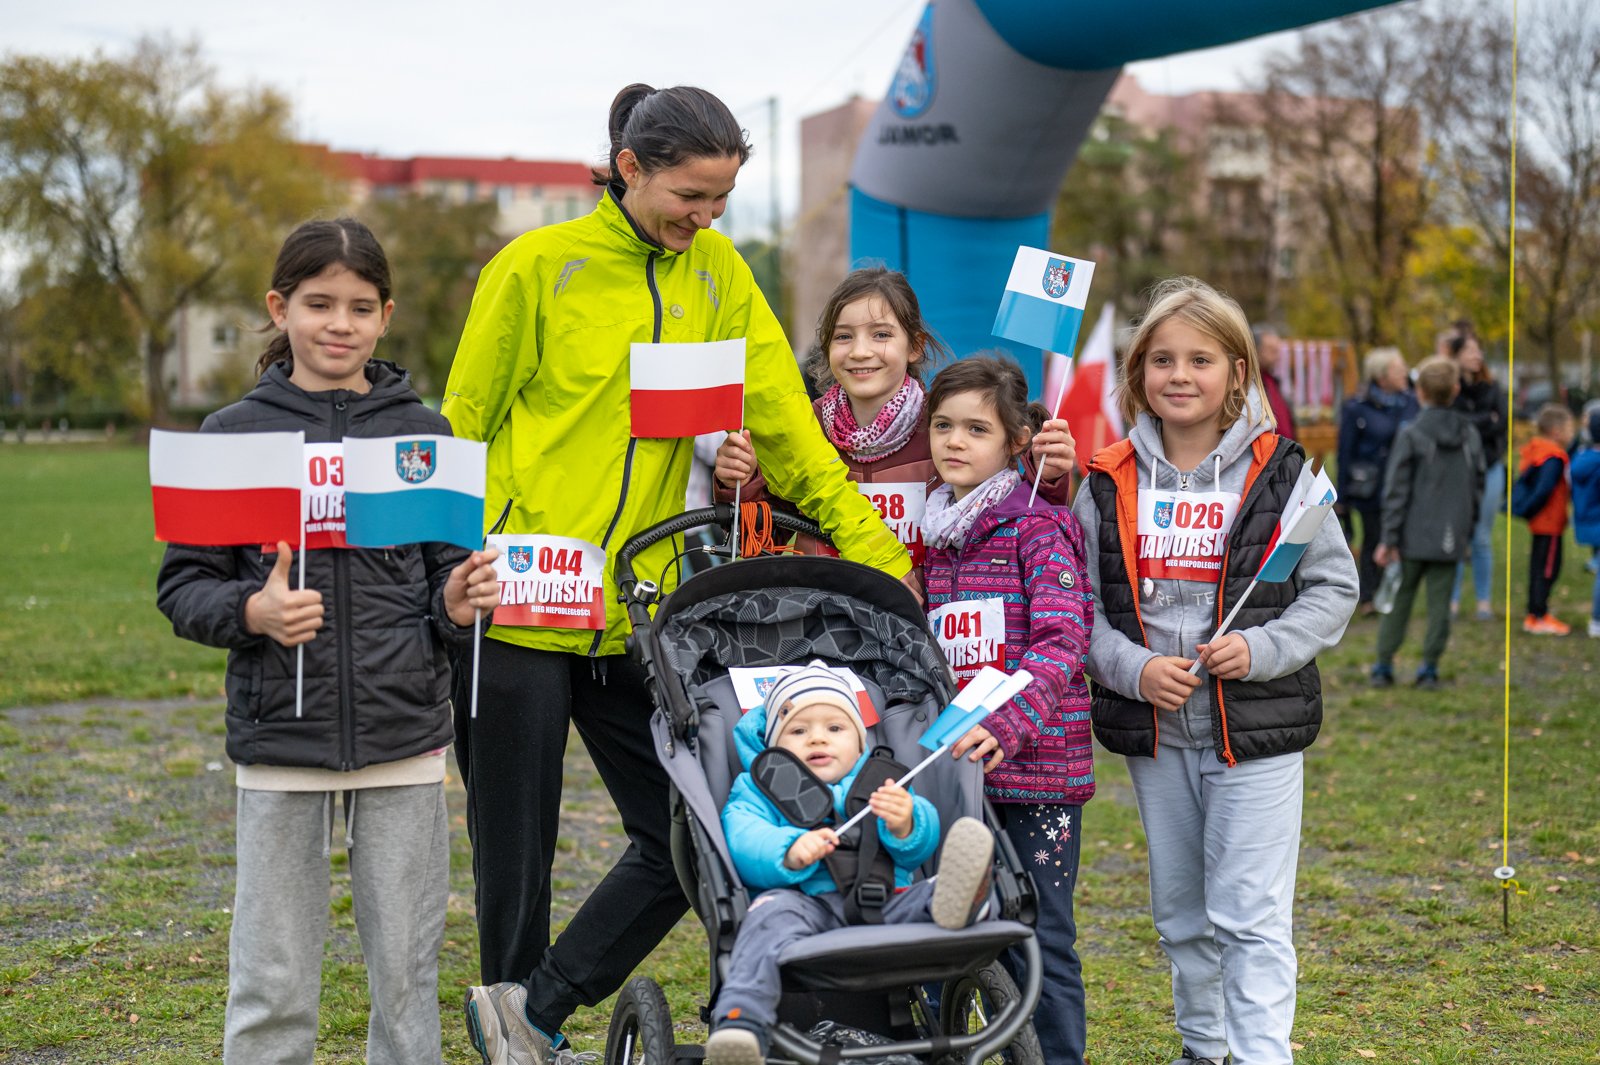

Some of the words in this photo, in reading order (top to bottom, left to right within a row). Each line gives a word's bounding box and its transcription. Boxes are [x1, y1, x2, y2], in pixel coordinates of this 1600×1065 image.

[309, 456, 344, 486] 03
[862, 493, 905, 520] 38
[1175, 501, 1224, 530] 026
[1139, 532, 1226, 559] JAWORSK
[538, 546, 583, 576] 044
[1165, 559, 1178, 567] BIEG
[531, 605, 545, 613] BIEG
[944, 611, 981, 640] 041
[943, 638, 998, 667] ORSKI
